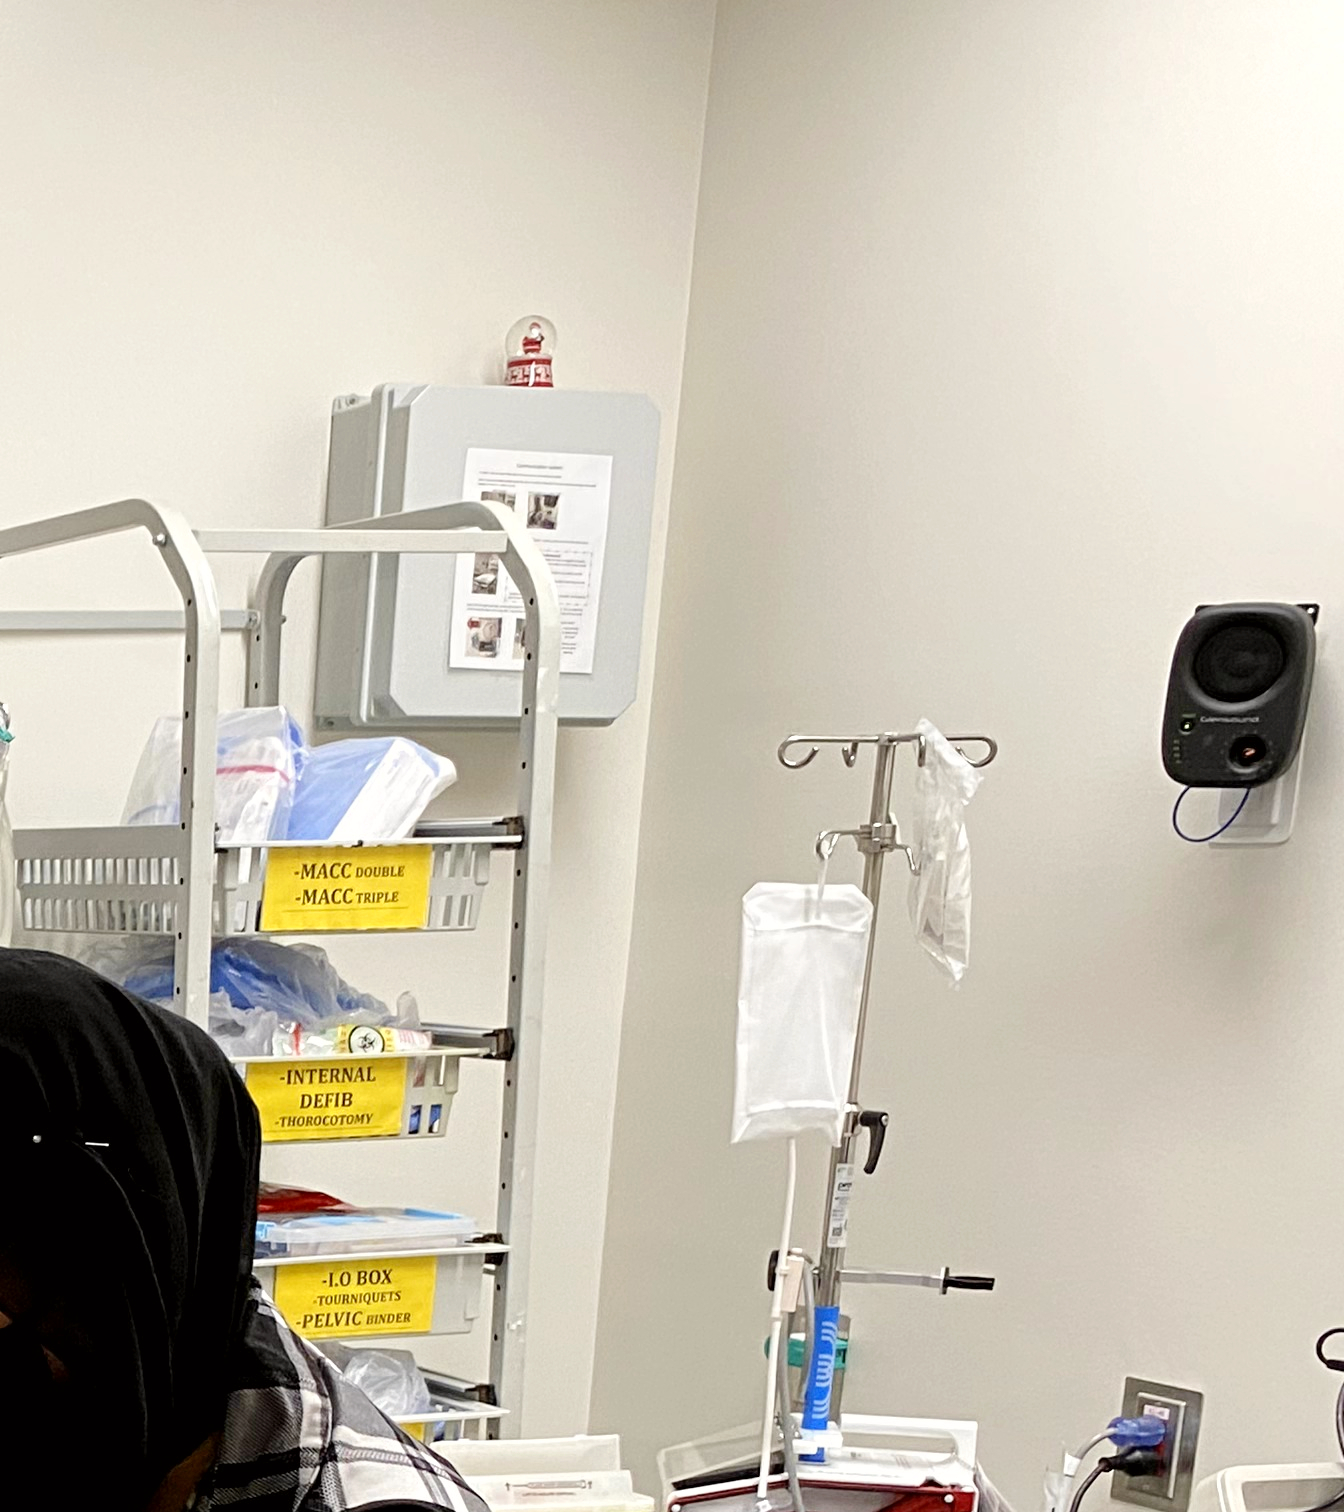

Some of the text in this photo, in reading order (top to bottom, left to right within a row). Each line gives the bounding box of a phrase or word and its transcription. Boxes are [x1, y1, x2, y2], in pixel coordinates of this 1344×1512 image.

[294, 863, 405, 880] -MACC DOUBLE
[295, 888, 399, 905] -MACC TRIPLE
[280, 1066, 376, 1085] -INTERNAL
[299, 1092, 353, 1109] DEFIB
[275, 1113, 373, 1128] -THOROCOTOMY
[356, 1268, 393, 1286] BOX
[313, 1290, 402, 1306] -TOURNIQUETS
[296, 1311, 411, 1328] -PELVIC BINDER
